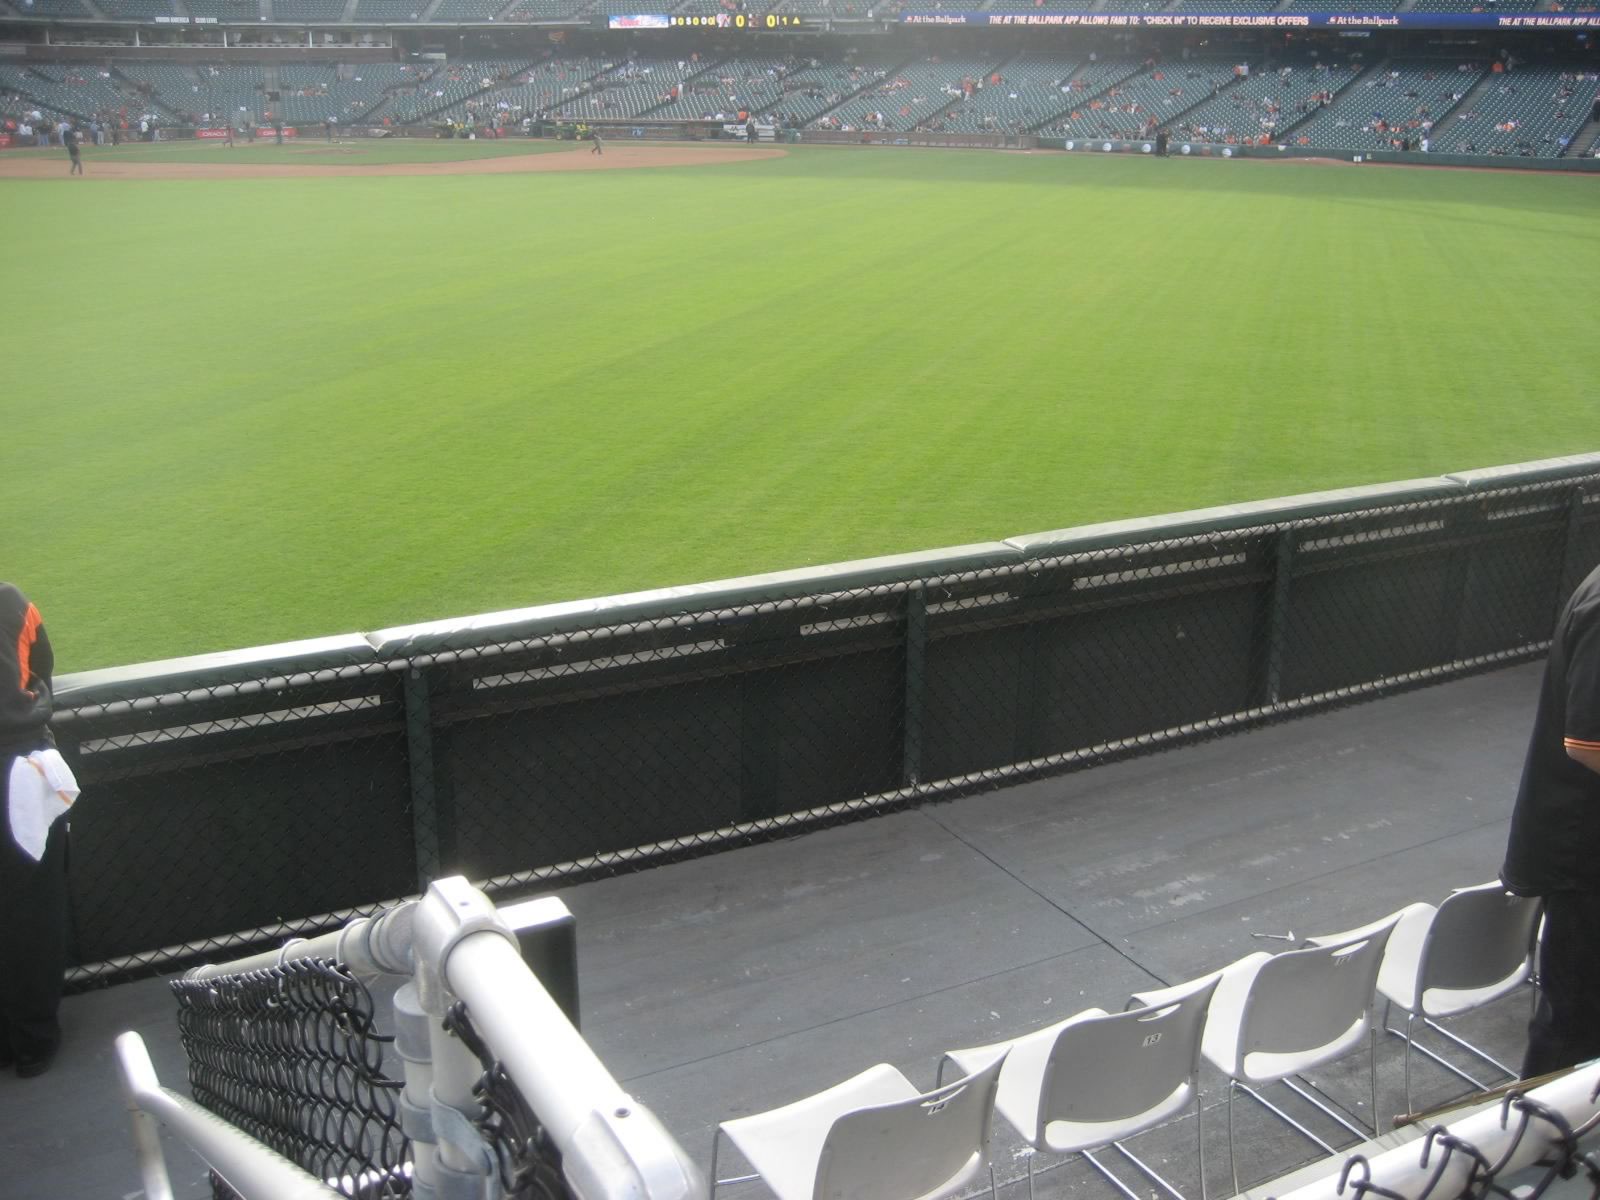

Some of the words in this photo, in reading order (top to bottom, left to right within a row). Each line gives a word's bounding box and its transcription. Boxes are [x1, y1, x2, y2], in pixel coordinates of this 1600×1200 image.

[935, 15, 966, 25] Ballpark
[989, 15, 1002, 25] THE
[1002, 15, 1012, 25] AT
[1013, 15, 1027, 25] THE
[1027, 15, 1064, 25] BALLPARK
[1064, 15, 1079, 25] APP
[1079, 15, 1109, 25] ALLOWS
[1109, 15, 1128, 25] FANS
[1187, 16, 1198, 25] TO
[1199, 16, 1232, 26] RECEIVE
[1233, 16, 1276, 26] EXCLUSIVE
[1277, 16, 1309, 26] OFFERS
[1336, 16, 1347, 25] At
[1348, 16, 1362, 25] the
[1362, 16, 1399, 26] Ballpark
[1498, 17, 1511, 26] THE
[1511, 17, 1522, 26] AT
[1522, 17, 1535, 26] THE
[1536, 17, 1572, 26] BALLPARK
[1572, 17, 1588, 26] APP
